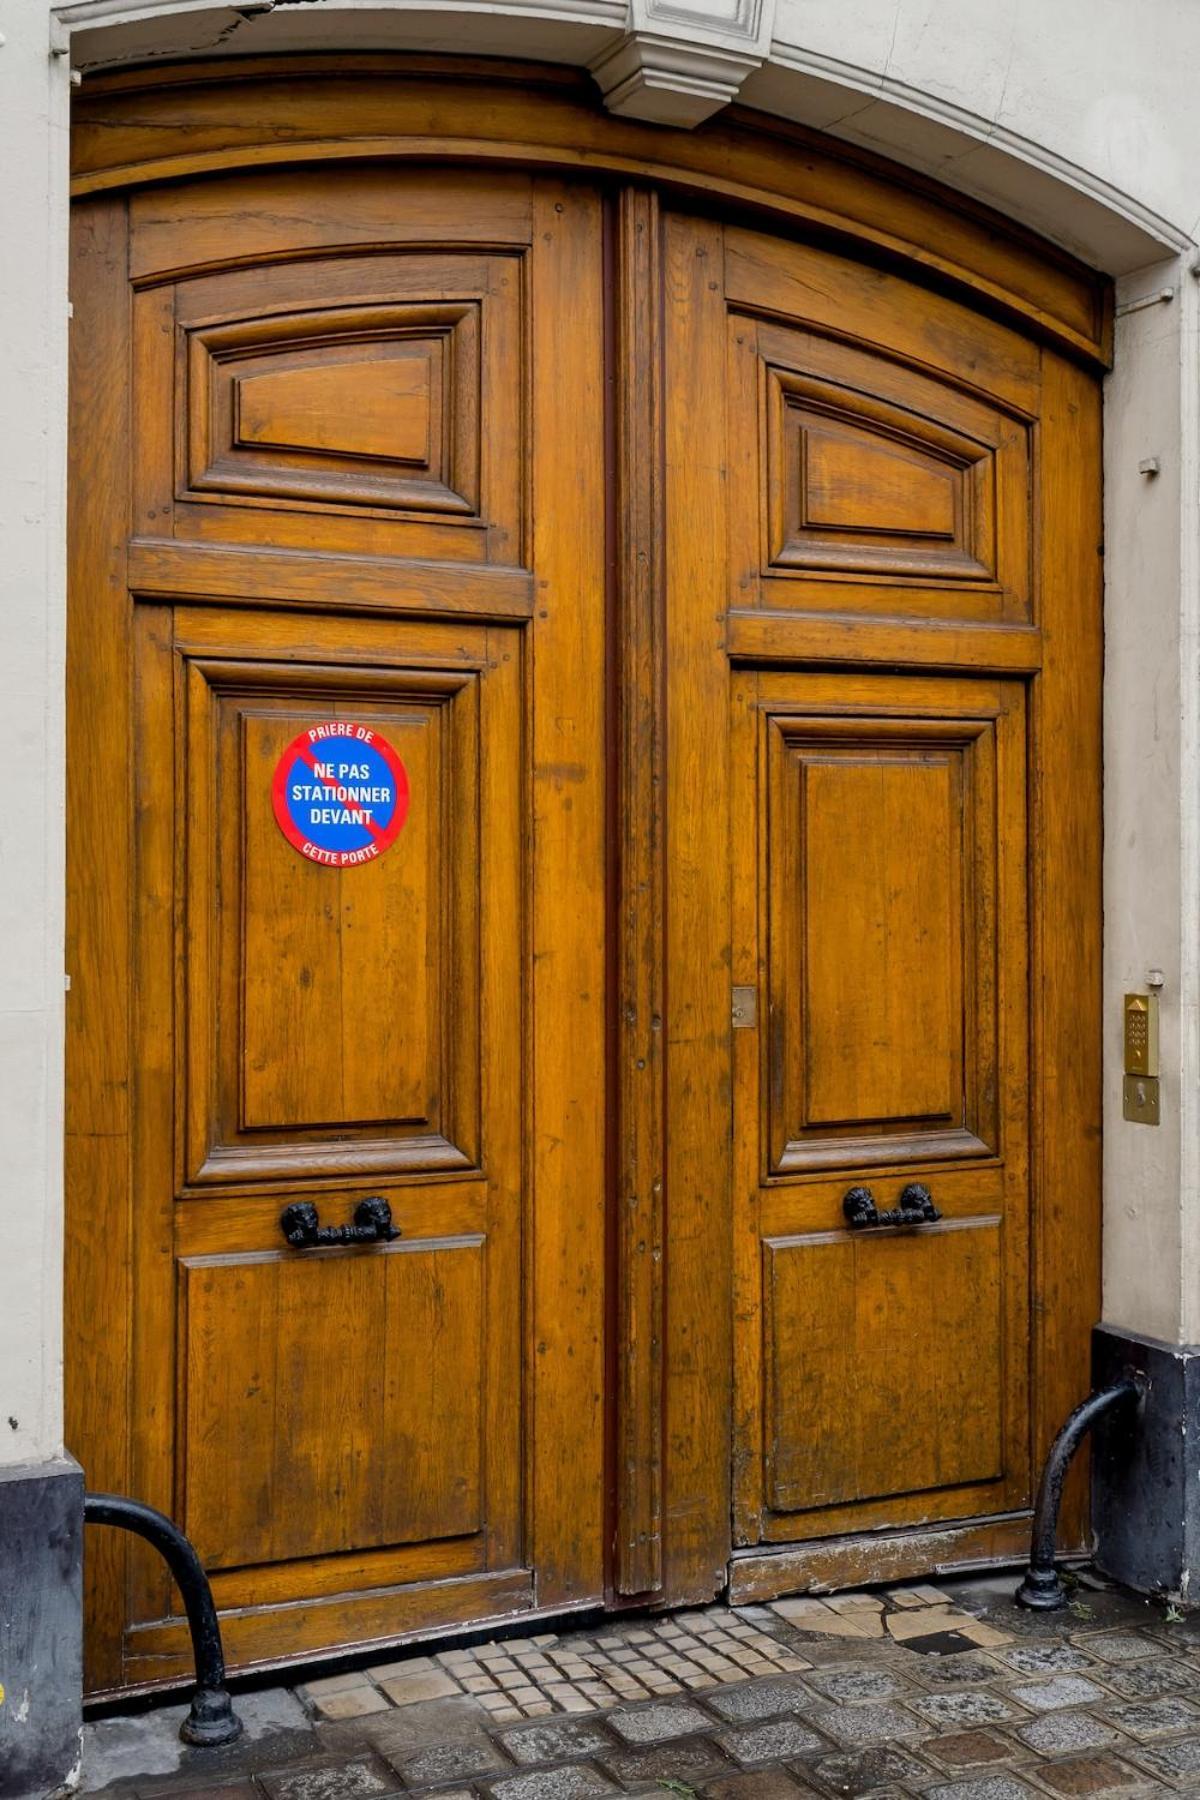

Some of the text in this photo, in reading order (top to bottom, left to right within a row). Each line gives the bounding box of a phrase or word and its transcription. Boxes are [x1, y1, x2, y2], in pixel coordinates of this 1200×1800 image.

[308, 723, 375, 743] PRIERE DE
[314, 763, 370, 779] NE PAS
[292, 785, 390, 802] STATIONNER
[310, 809, 373, 824] DEVANT
[303, 842, 379, 864] CETTE PORTE
